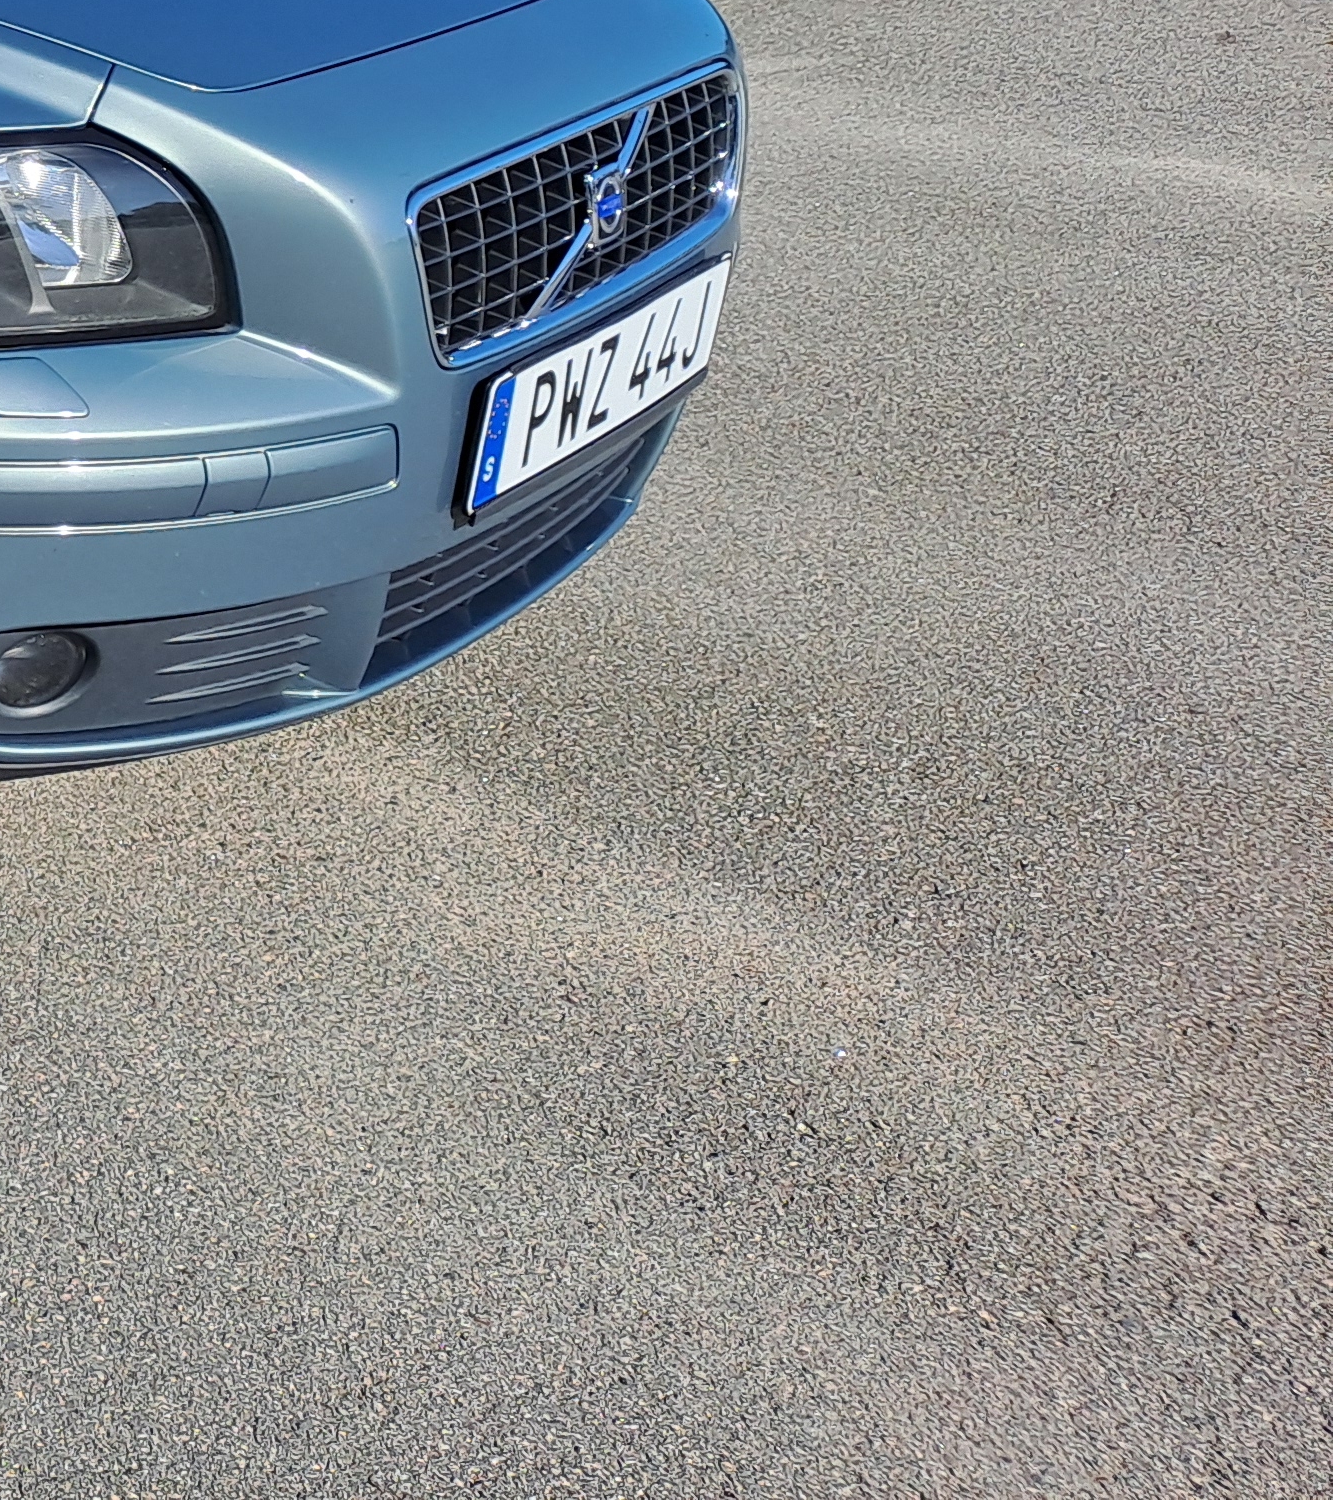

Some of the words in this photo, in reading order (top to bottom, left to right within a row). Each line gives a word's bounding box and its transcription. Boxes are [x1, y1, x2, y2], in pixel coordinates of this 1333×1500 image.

[522, 332, 620, 468] PWZ
[628, 281, 712, 400] 44J
[482, 455, 495, 483] S
